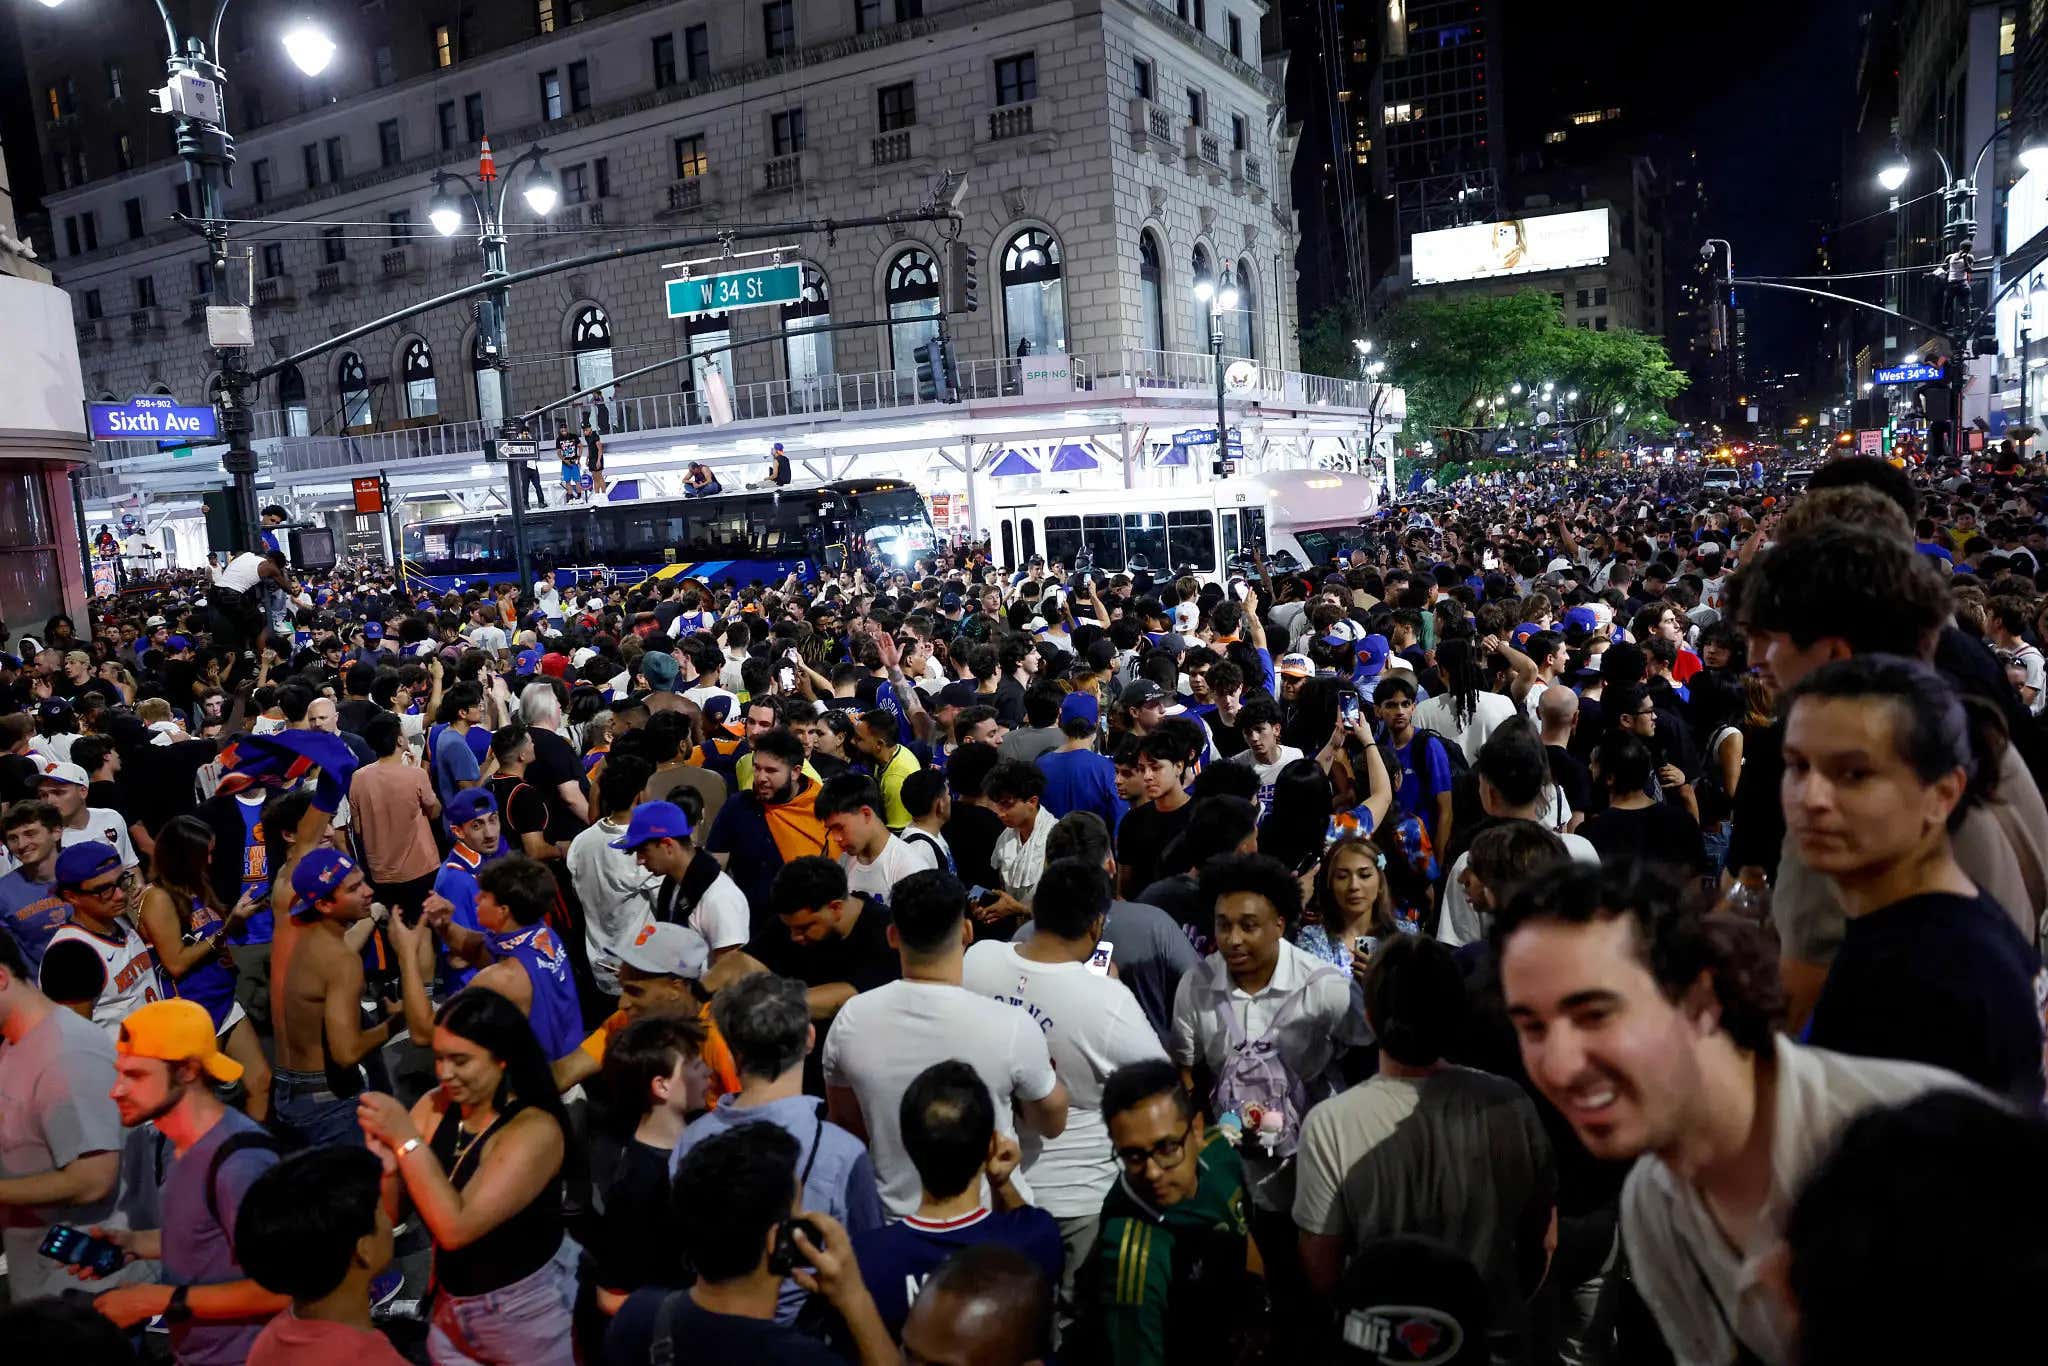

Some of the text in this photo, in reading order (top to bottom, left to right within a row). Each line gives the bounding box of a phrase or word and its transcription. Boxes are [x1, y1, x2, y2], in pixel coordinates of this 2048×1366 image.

[701, 277, 763, 305] W 34 St
[1027, 369, 1067, 380] SPRING
[1879, 368, 1939, 382] West 34th St
[135, 400, 172, 408] 958 902
[108, 411, 200, 431] Sixth Ave
[503, 446, 532, 454] ONE WAY
